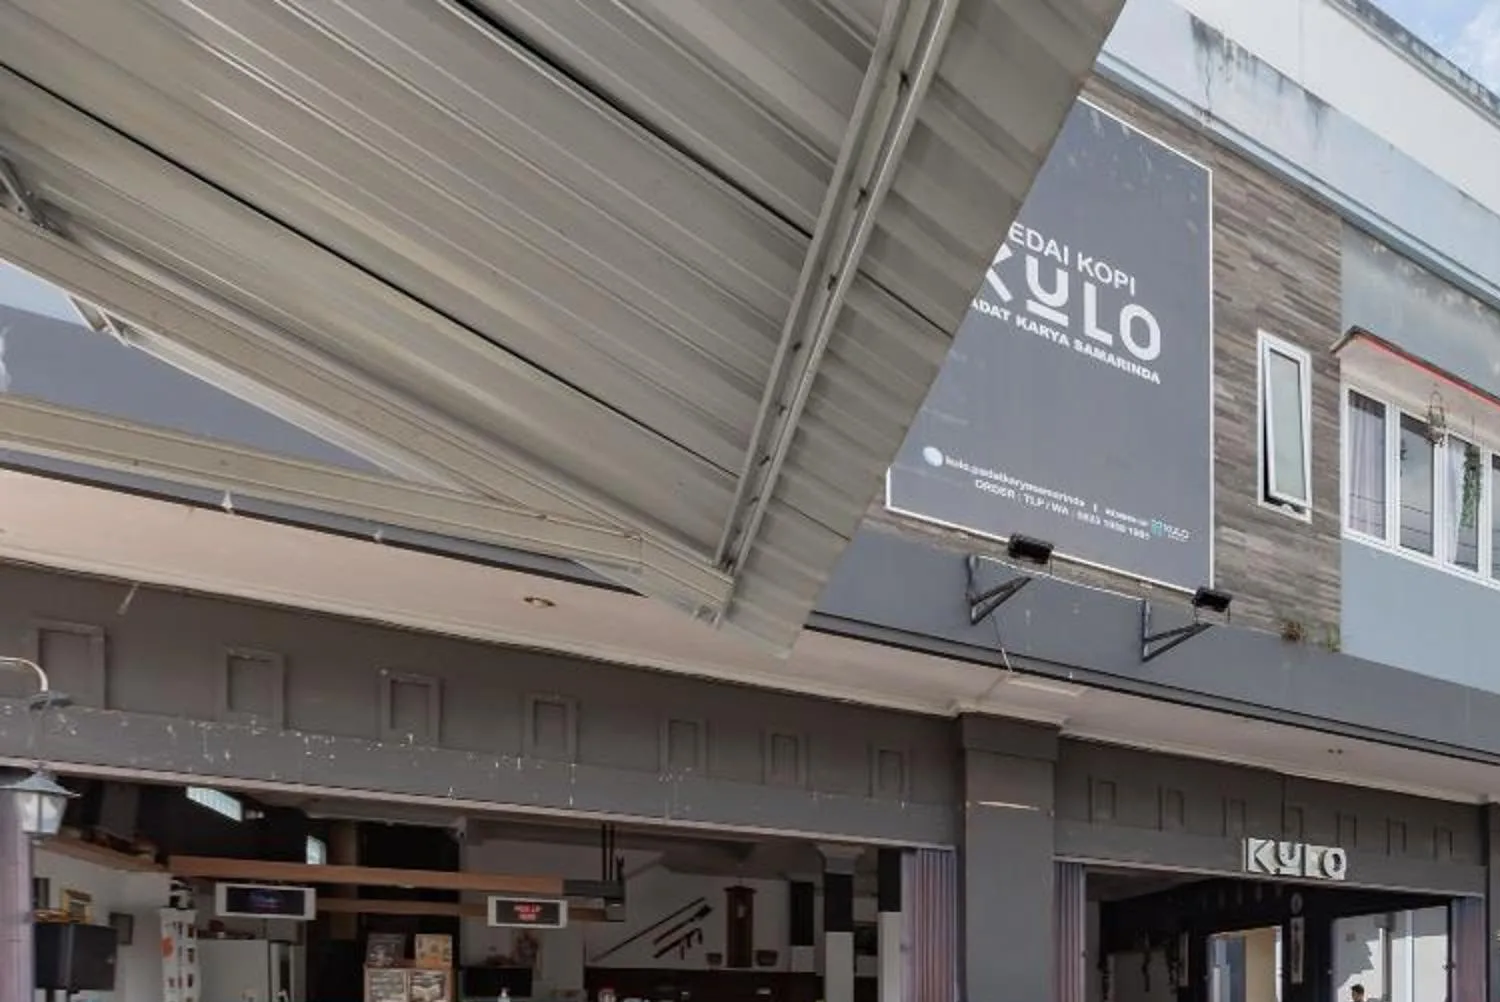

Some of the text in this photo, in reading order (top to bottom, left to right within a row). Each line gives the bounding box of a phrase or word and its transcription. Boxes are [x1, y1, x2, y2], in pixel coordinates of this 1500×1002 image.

[1008, 220, 1135, 297] EDAI KOPI
[972, 298, 1161, 385] ADAT KARYA SAMARINDA
[1241, 837, 1347, 880] KULO
